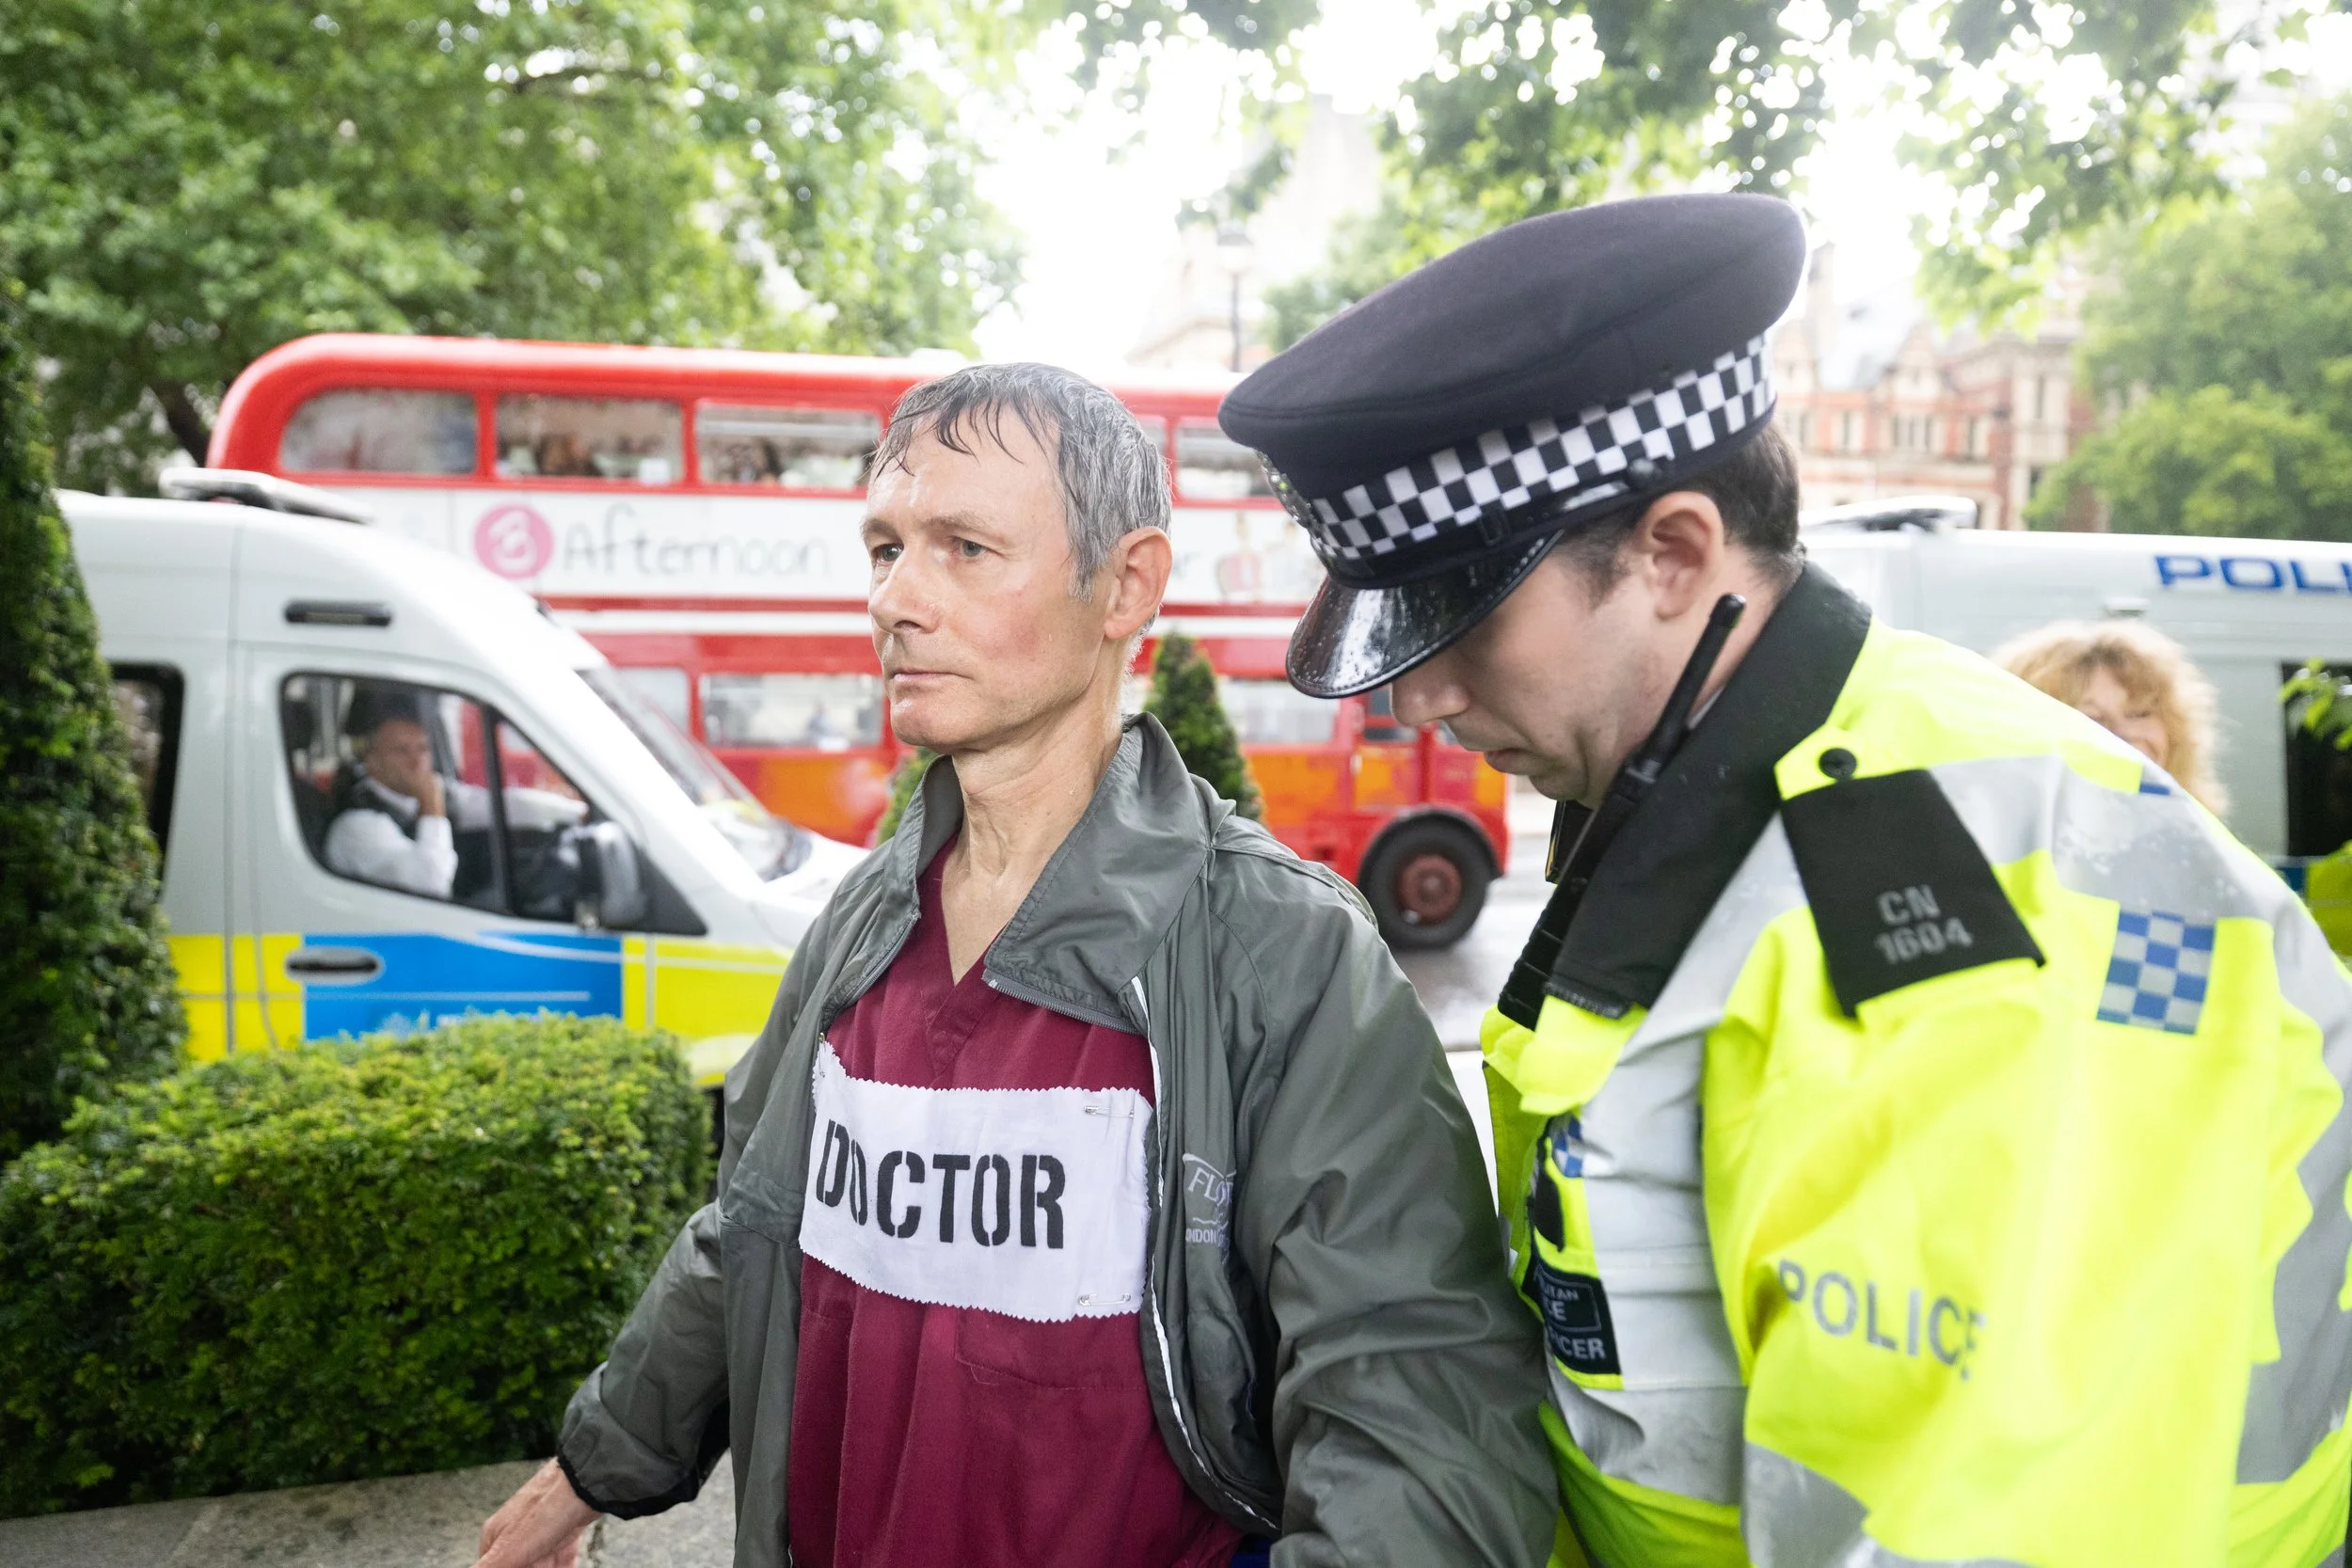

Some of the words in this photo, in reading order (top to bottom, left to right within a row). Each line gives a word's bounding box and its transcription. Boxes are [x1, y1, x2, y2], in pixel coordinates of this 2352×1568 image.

[564, 501, 832, 577] Afternoon
[1878, 884, 1941, 926] CN
[1875, 917, 1973, 965] 1604
[816, 1119, 1066, 1249] DOCTOR
